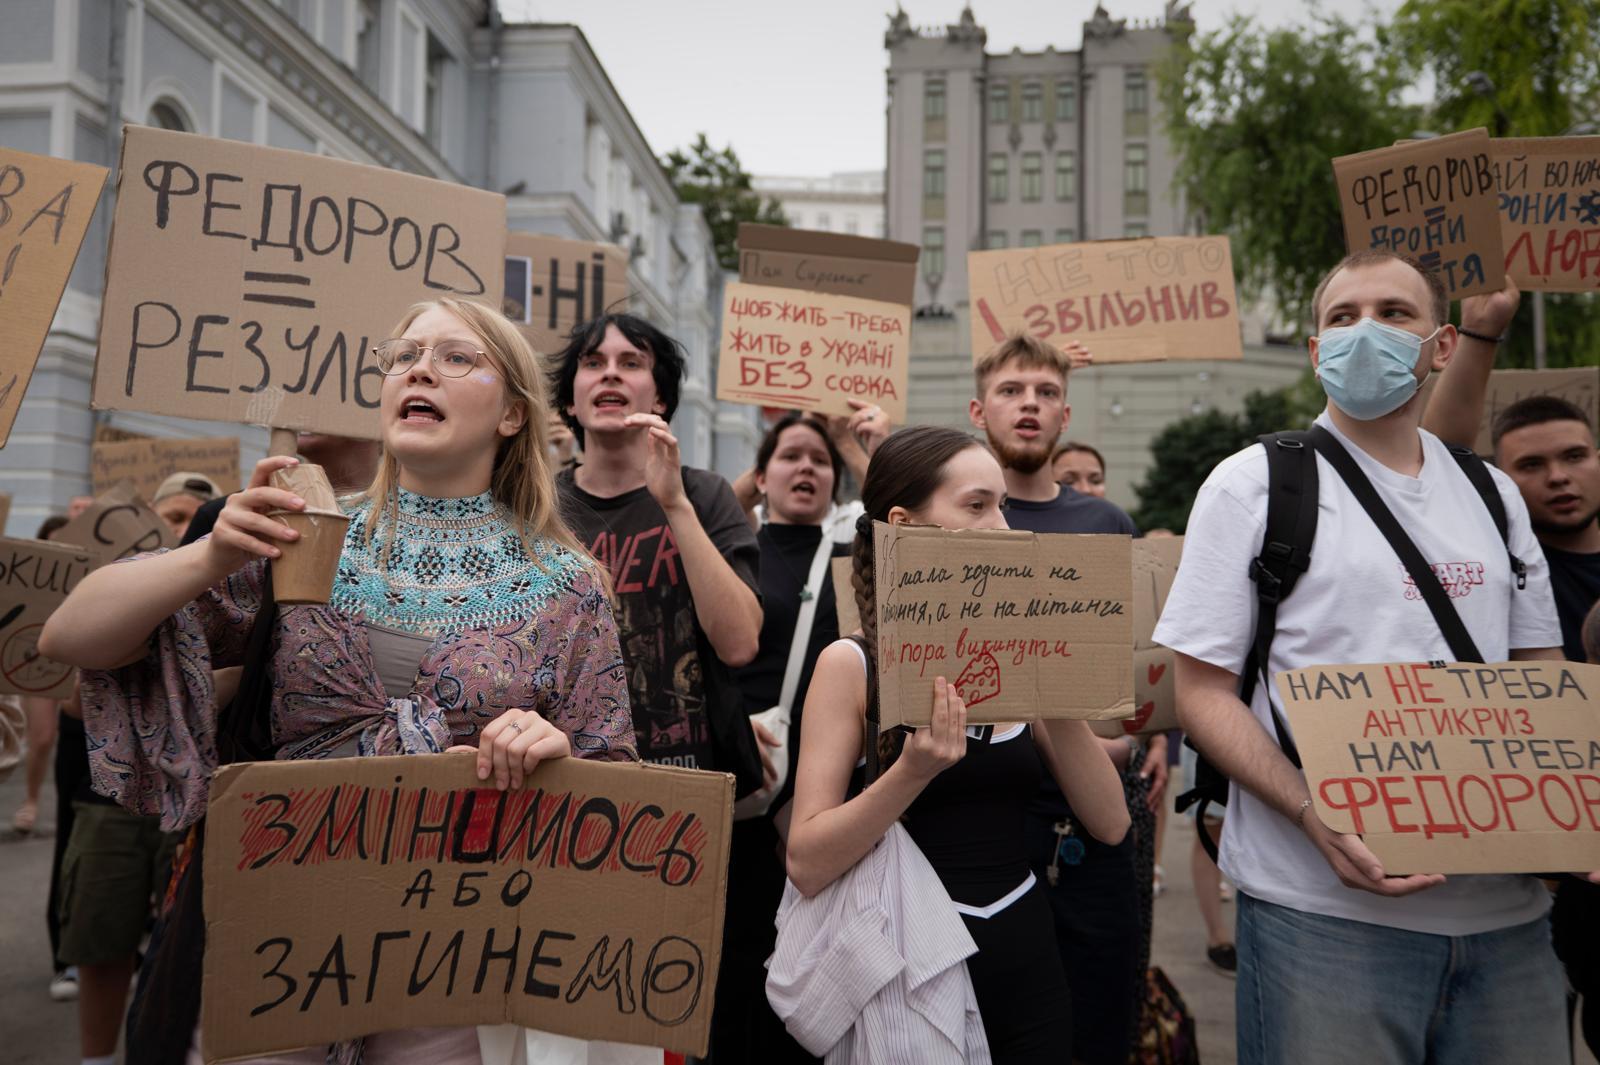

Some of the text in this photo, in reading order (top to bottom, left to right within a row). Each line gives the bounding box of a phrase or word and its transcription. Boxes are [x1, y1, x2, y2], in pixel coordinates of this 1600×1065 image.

[1352, 153, 1494, 220] ФЕДОРОВ
[143, 160, 485, 295] ФЕДОРОВ
[1370, 214, 1466, 252] ДРОНИ
[994, 240, 1227, 306] НЕ ТОГО
[775, 300, 827, 327] ЖИТЬ
[845, 311, 903, 335] ТРЕБА
[1023, 281, 1230, 340] ЗВІЛЬНИВ
[729, 326, 791, 356] ЖИТЬ
[819, 336, 894, 368] УКРАЇНІ
[739, 356, 812, 390] БЕЗ
[898, 566, 953, 589] мала
[960, 562, 1034, 598] ходити
[1050, 565, 1083, 582] на
[936, 602, 951, 622] а
[960, 600, 983, 619] не
[994, 600, 1021, 617] на
[899, 642, 947, 678] пора
[956, 628, 1073, 666] викинути
[1286, 664, 1588, 705] НАМ НЕ ТРЕБА
[1362, 709, 1535, 739] АНТИКРИЗ
[1348, 741, 1441, 773] НАМ
[1318, 774, 1600, 840] ФЕДОРОВ
[250, 776, 698, 886] ЗМІНИМОСЬ
[400, 868, 533, 910] АБО
[250, 925, 704, 1026] ЗАГИНЕМО
